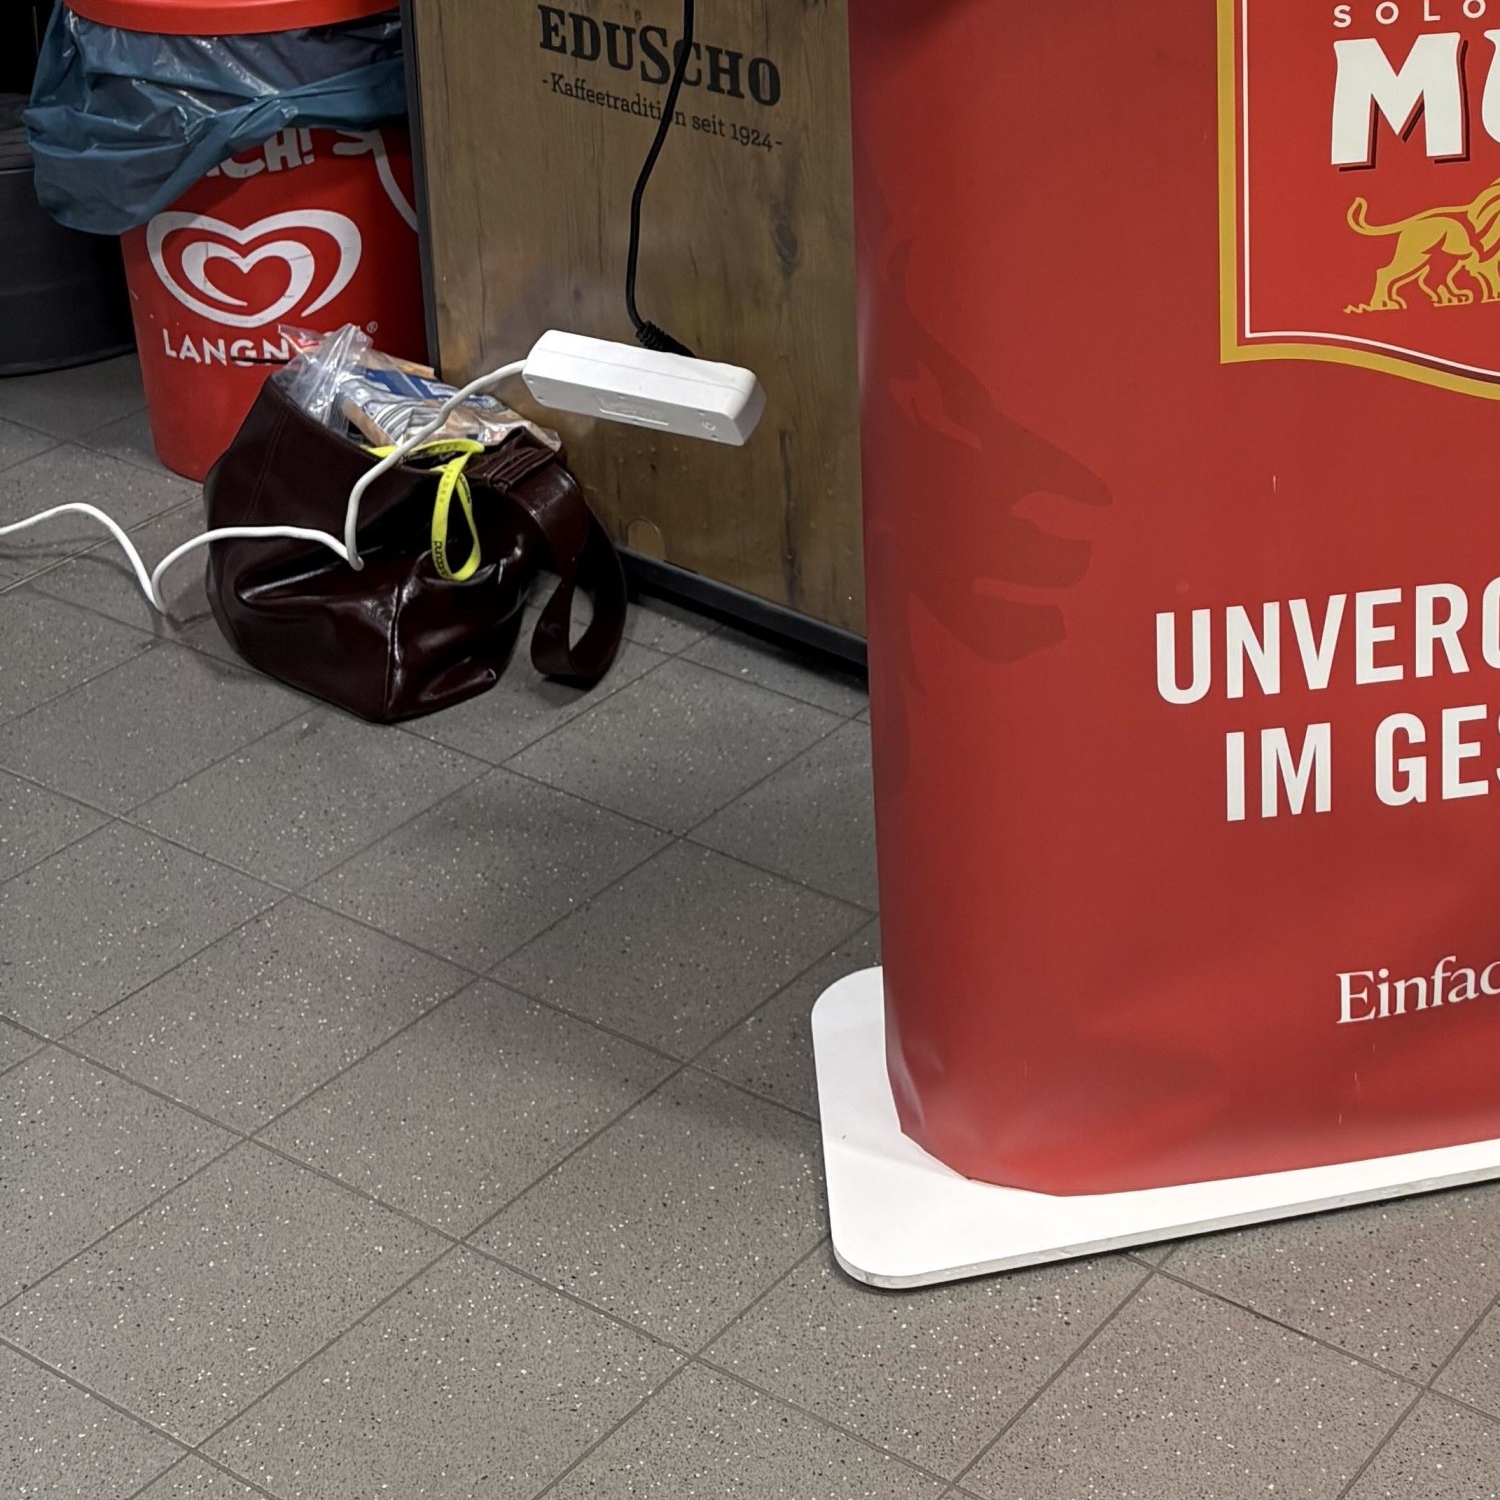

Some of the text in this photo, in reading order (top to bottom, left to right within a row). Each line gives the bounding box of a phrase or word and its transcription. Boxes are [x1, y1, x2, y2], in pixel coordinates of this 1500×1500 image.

[538, 4, 781, 107] EDUSCHO
[542, 73, 686, 127] -Kaffeetraditin
[692, 115, 725, 138] seit
[1225, 722, 1332, 822] IM
